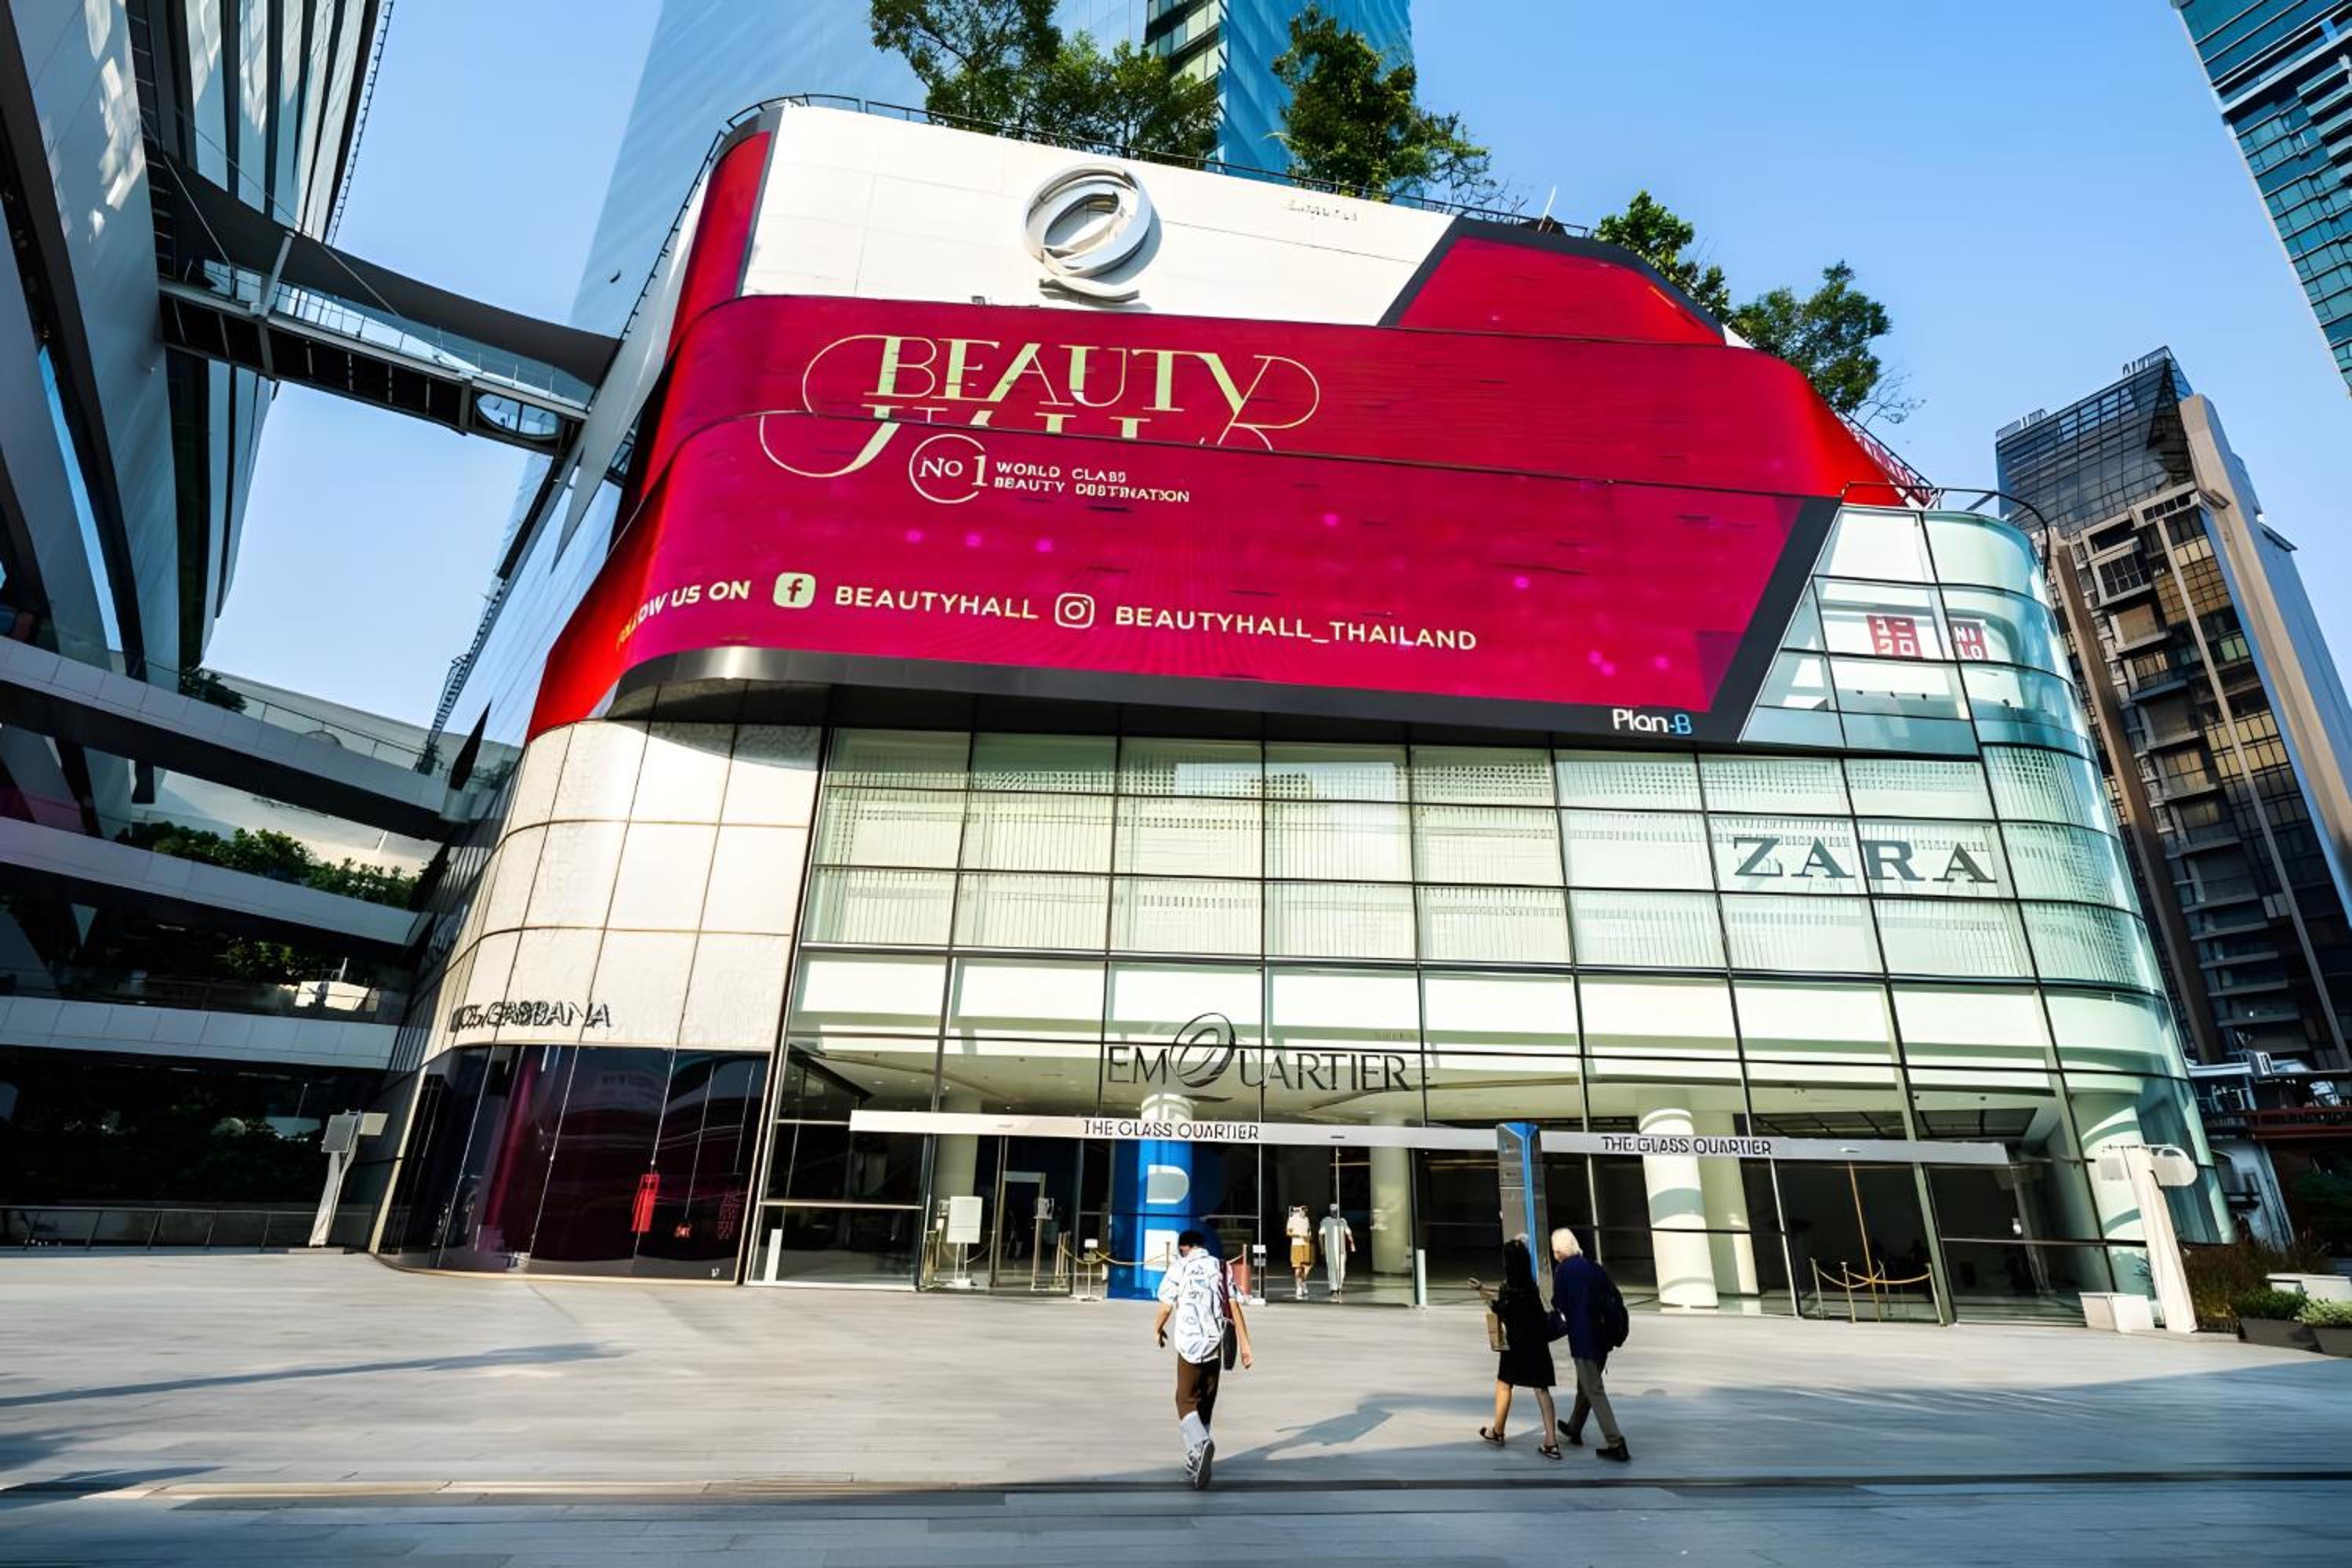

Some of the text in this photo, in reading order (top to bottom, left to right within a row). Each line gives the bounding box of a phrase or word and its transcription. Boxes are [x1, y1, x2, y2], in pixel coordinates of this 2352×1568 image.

[803, 335, 1319, 417] BEAUTY
[971, 455, 988, 486] 1
[996, 461, 1126, 483] WORLD CLASS
[994, 476, 1189, 502] BEAUTY DESTINATION
[671, 585, 701, 608] US
[709, 580, 751, 601] ON
[835, 586, 1040, 619] BEAUTYHALL
[1116, 605, 1477, 651] BEAUTYHALL_THAILAND
[1954, 626, 1976, 642] NI
[1957, 644, 1983, 659] LO
[1733, 837, 1998, 884] ZARA
[1084, 1120, 1112, 1135] THE
[1602, 1136, 1635, 1151] THE
